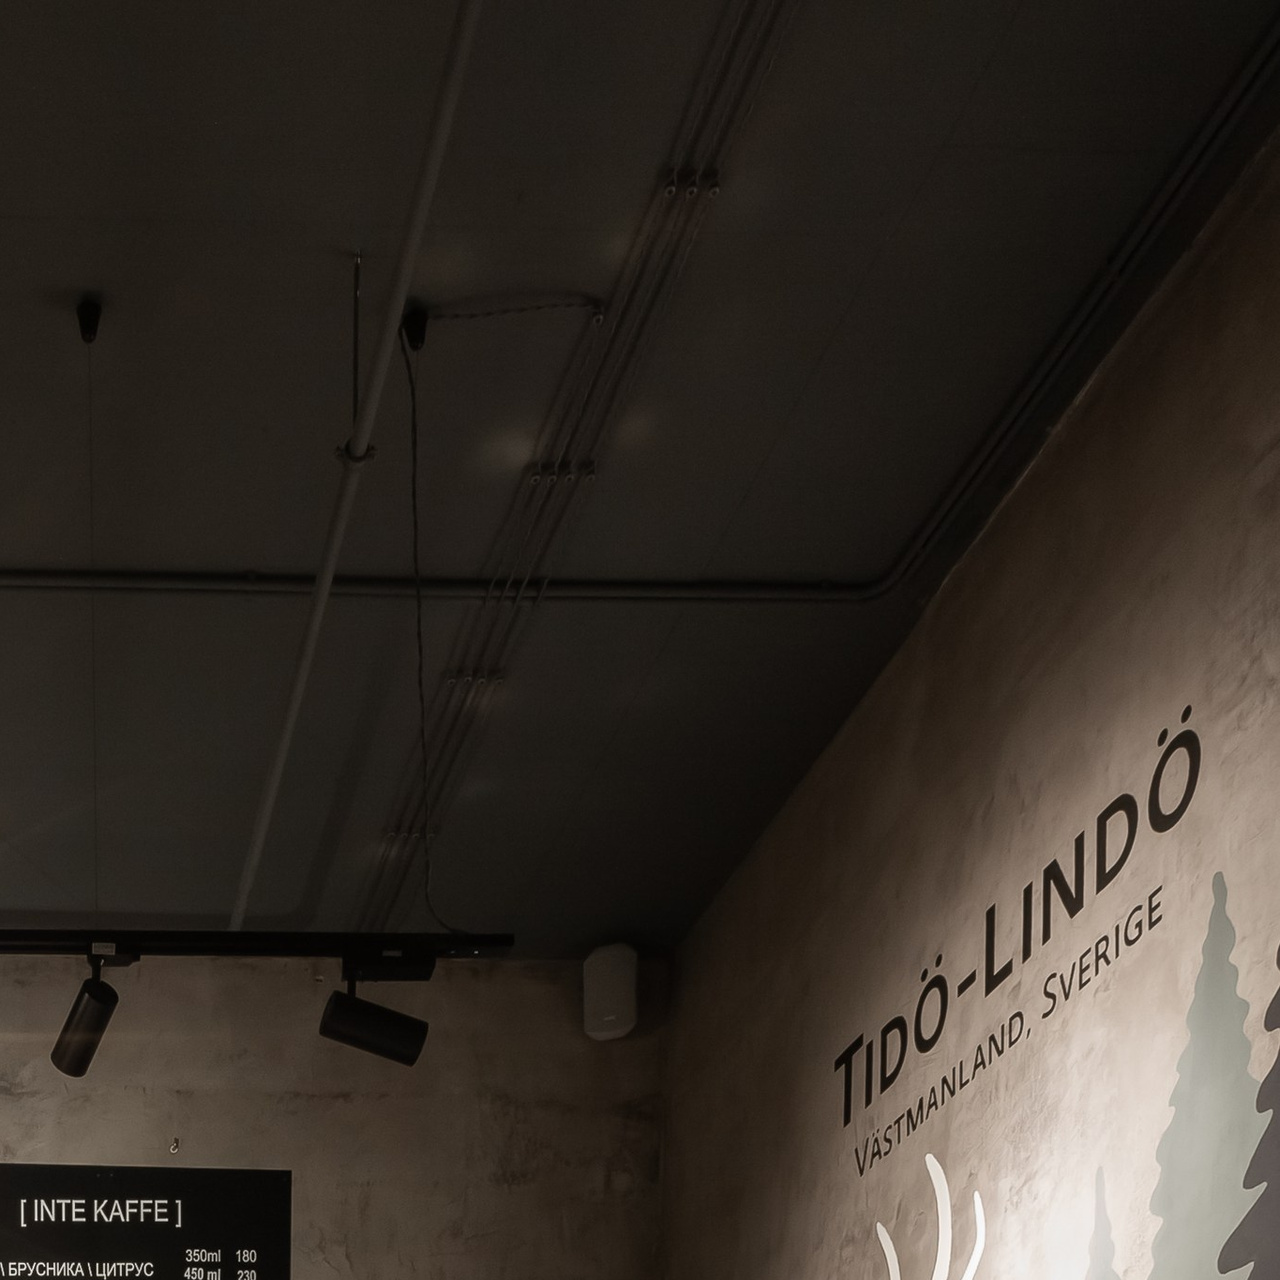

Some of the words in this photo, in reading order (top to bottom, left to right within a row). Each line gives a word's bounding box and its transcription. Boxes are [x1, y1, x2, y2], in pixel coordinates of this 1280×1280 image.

[834, 704, 1201, 1128] TIDÖ-LINDÖ
[1042, 885, 1163, 1019] SVERIGE
[34, 1200, 86, 1222] INTE
[94, 1200, 168, 1222] KAFFE
[185, 1250, 221, 1263] 350ml
[236, 1250, 257, 1263] 180
[8, 1263, 84, 1277] БРУСНИКА
[96, 1263, 154, 1280] ЦИТРУС
[184, 1268, 204, 1280] 450
[207, 1269, 220, 1280] ml
